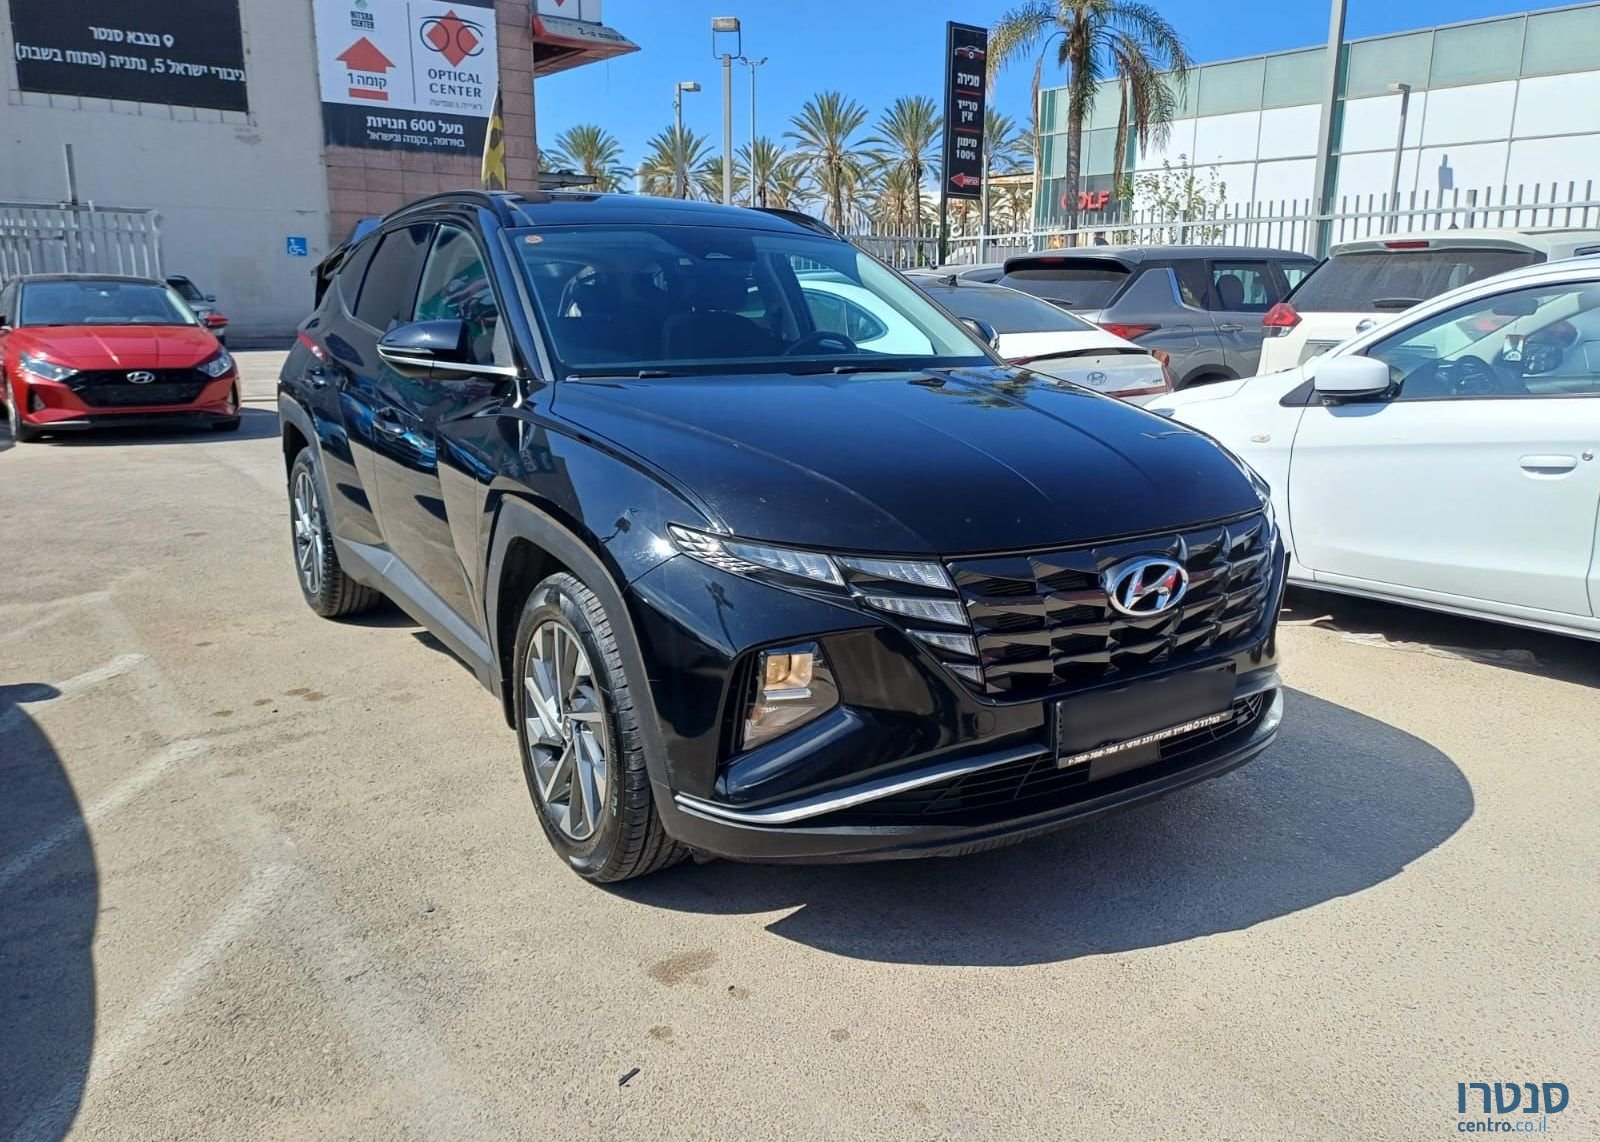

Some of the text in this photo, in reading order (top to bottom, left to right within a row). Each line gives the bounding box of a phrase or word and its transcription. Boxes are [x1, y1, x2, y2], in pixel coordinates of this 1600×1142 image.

[109, 55, 147, 71] נתניה
[166, 59, 208, 76] ישראל
[347, 72, 387, 90] קומה 1
[428, 68, 482, 84] OPTICAL
[957, 72, 980, 87] מכירה
[429, 83, 481, 97] CENTER
[957, 99, 978, 111] טרייד
[962, 111, 973, 123] אין
[366, 116, 463, 134] מעל 600 חנויות
[957, 136, 977, 148] מימון
